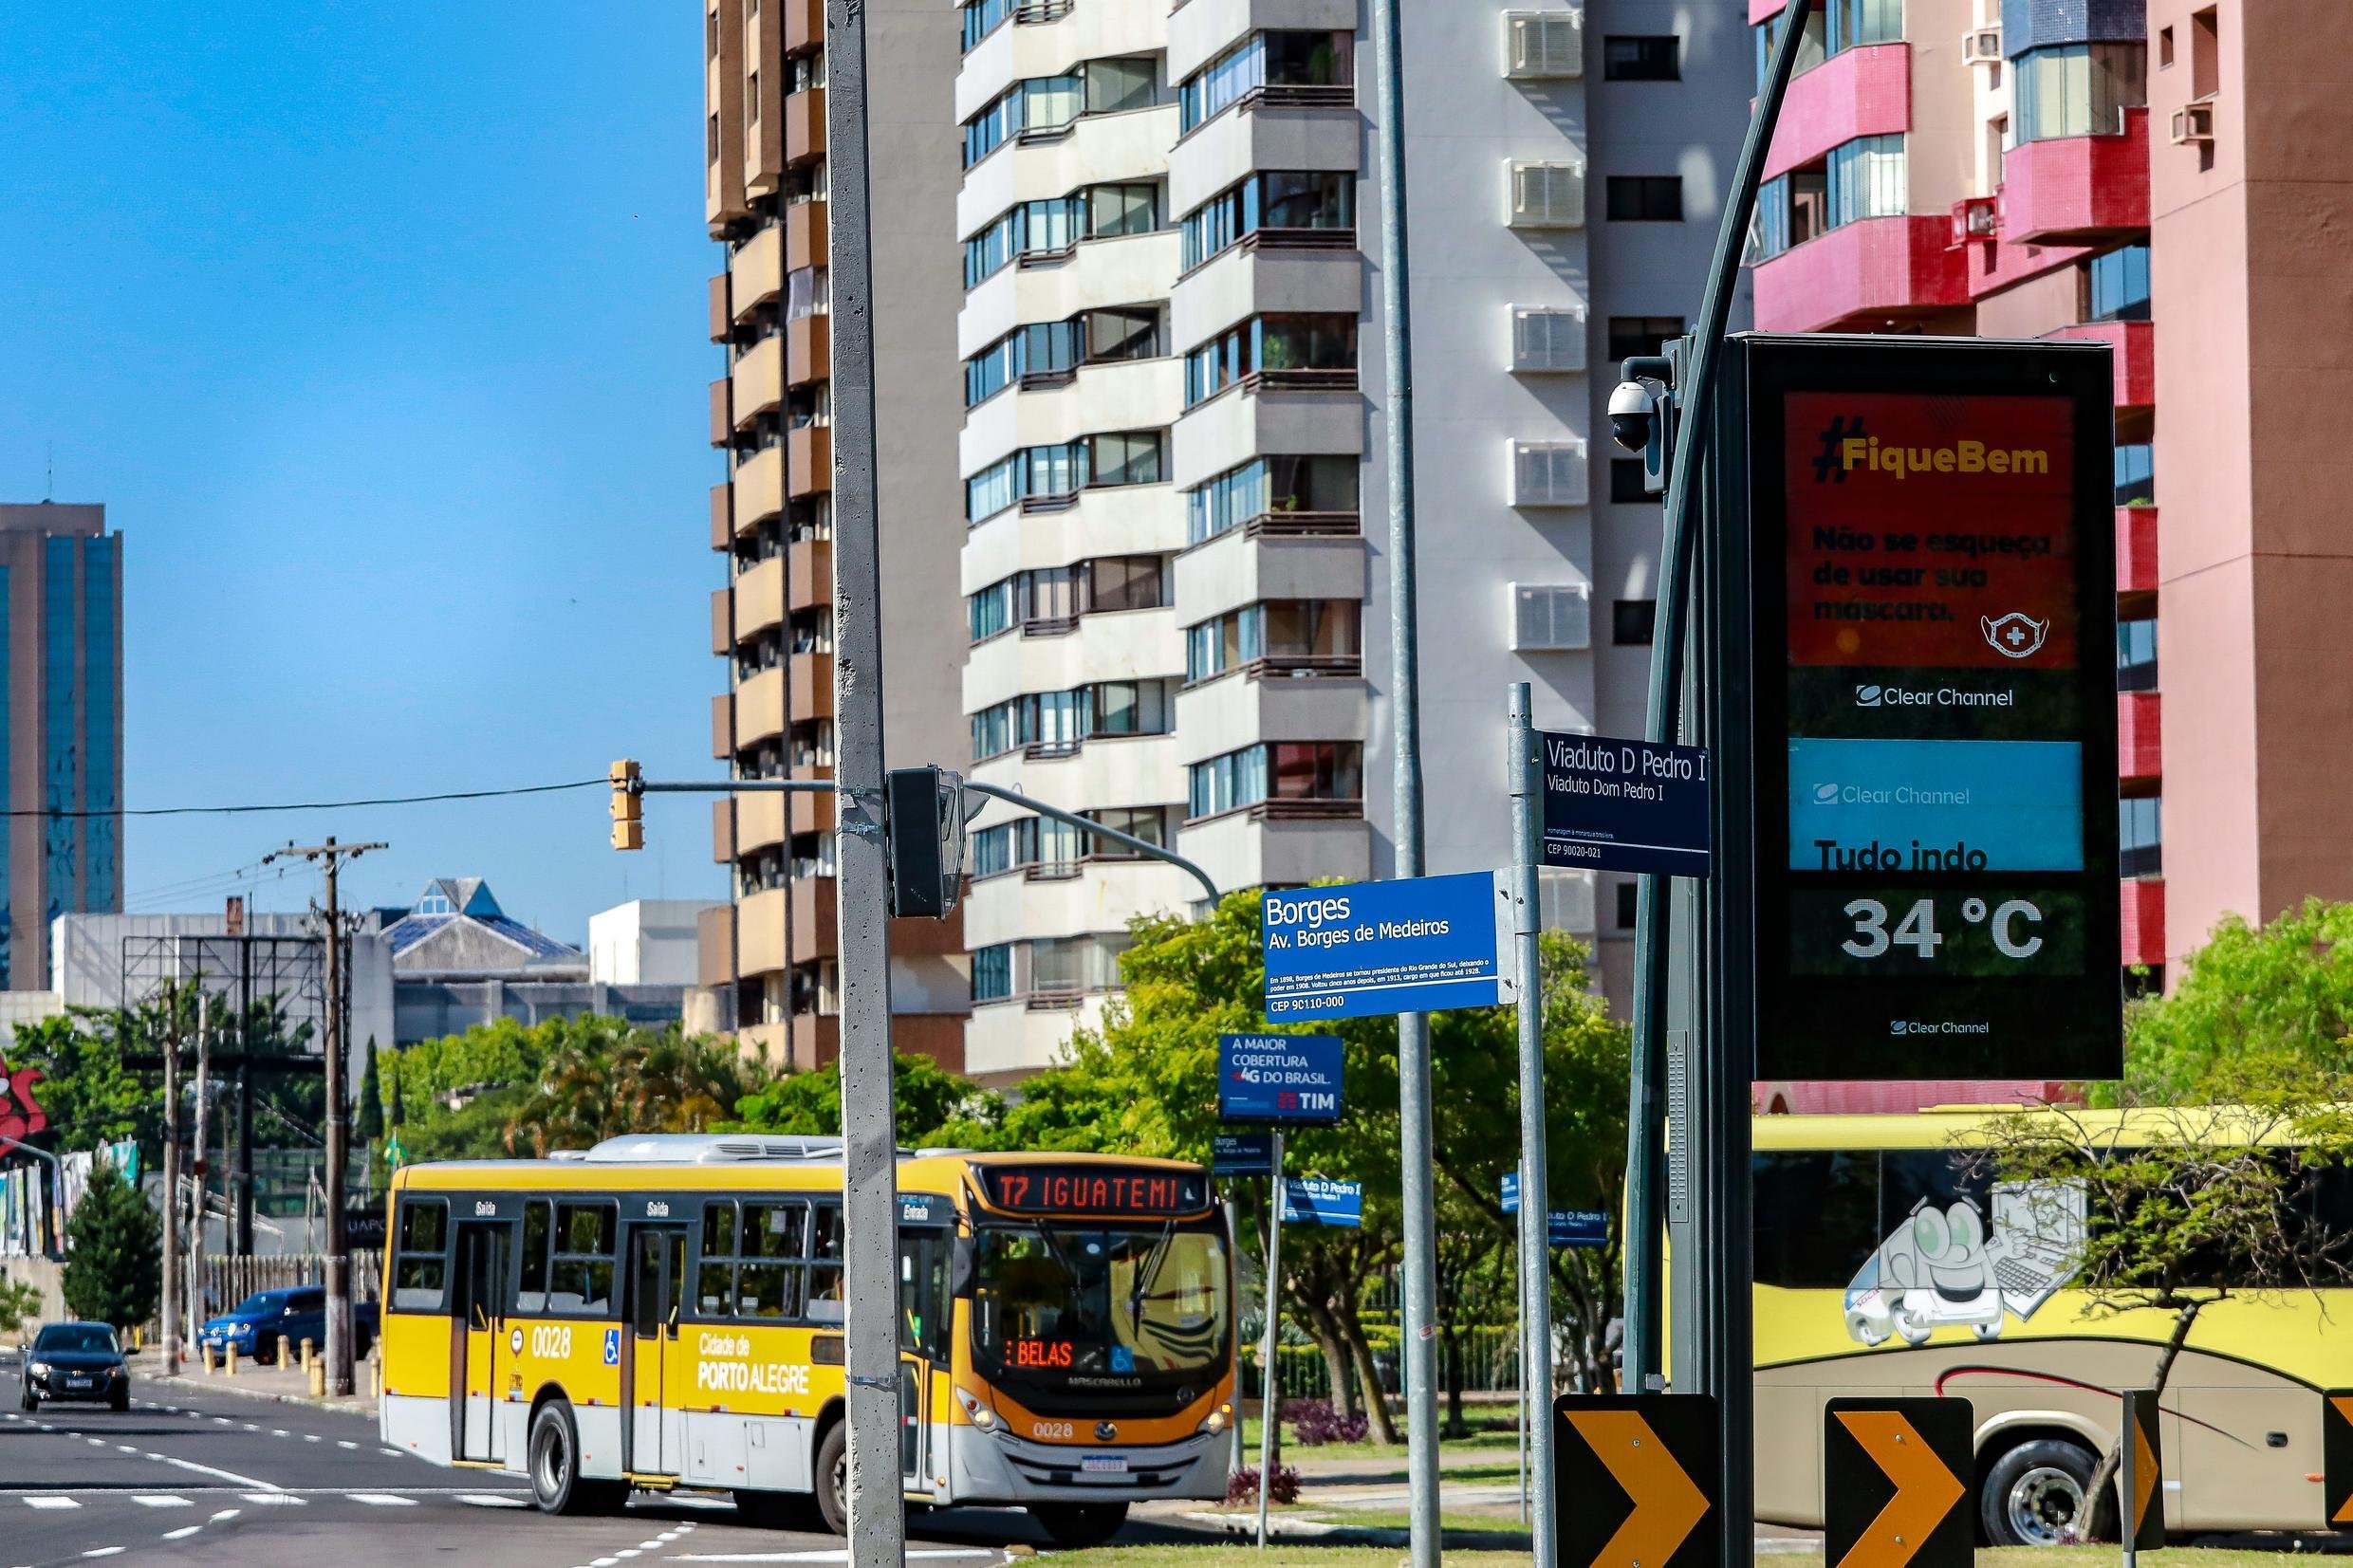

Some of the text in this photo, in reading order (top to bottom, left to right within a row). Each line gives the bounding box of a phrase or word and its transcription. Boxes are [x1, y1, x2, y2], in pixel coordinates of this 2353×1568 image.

[1811, 415, 2047, 484] #FiqueBem
[1813, 526, 2051, 561] Não se esqueça
[1813, 561, 1988, 588] de usar sua
[1884, 688, 2013, 707] Clear Channel
[1547, 739, 1706, 782] Viaduto D Pedro I
[1547, 774, 1663, 801] Viaduto Dom Pedro I
[1843, 785, 1970, 804] Clear Channel
[1547, 843, 1601, 858] CEP 90020-021
[1813, 839, 1988, 871] Tudo indo
[1266, 896, 1351, 929] Borges
[1269, 918, 1450, 950] Av. Borges de Medeiros
[1841, 898, 1943, 959] 34
[1269, 984, 1285, 992] poder
[1357, 976, 1376, 986] depois,
[1386, 973, 1402, 982] 1913,
[1454, 968, 1464, 976] até
[1465, 967, 1481, 975] 1928.
[1295, 974, 1313, 983] Borges
[1322, 970, 1345, 979] Medeiros
[1372, 965, 1399, 976] presidente
[1400, 965, 1408, 973] do
[1417, 962, 1437, 970] Grande
[1447, 960, 1458, 969] Sul,
[1458, 958, 1484, 968] deixando
[1270, 995, 1344, 1013] CEP 90110-000
[1908, 1022, 1989, 1034] Clear Channel
[1232, 1038, 1287, 1051] A MAIOR
[1232, 1054, 1308, 1068] COBERTURA
[1240, 1067, 1331, 1085] 4G DO BRASIL.
[1299, 1092, 1334, 1110] TIM
[1000, 1175, 1178, 1208] T7 IGUATEMI
[1320, 1181, 1329, 1193] D
[1329, 1182, 1355, 1195] Pedro
[475, 1200, 496, 1217] Saída
[646, 1200, 670, 1218] Saída
[903, 1204, 929, 1221] Entrada
[532, 1325, 571, 1359] 0028
[698, 1332, 750, 1357] Cidade de
[1017, 1340, 1073, 1367] BELAS
[697, 1360, 810, 1395] PORTO ALEGRE
[1033, 1422, 1073, 1438] 0028
